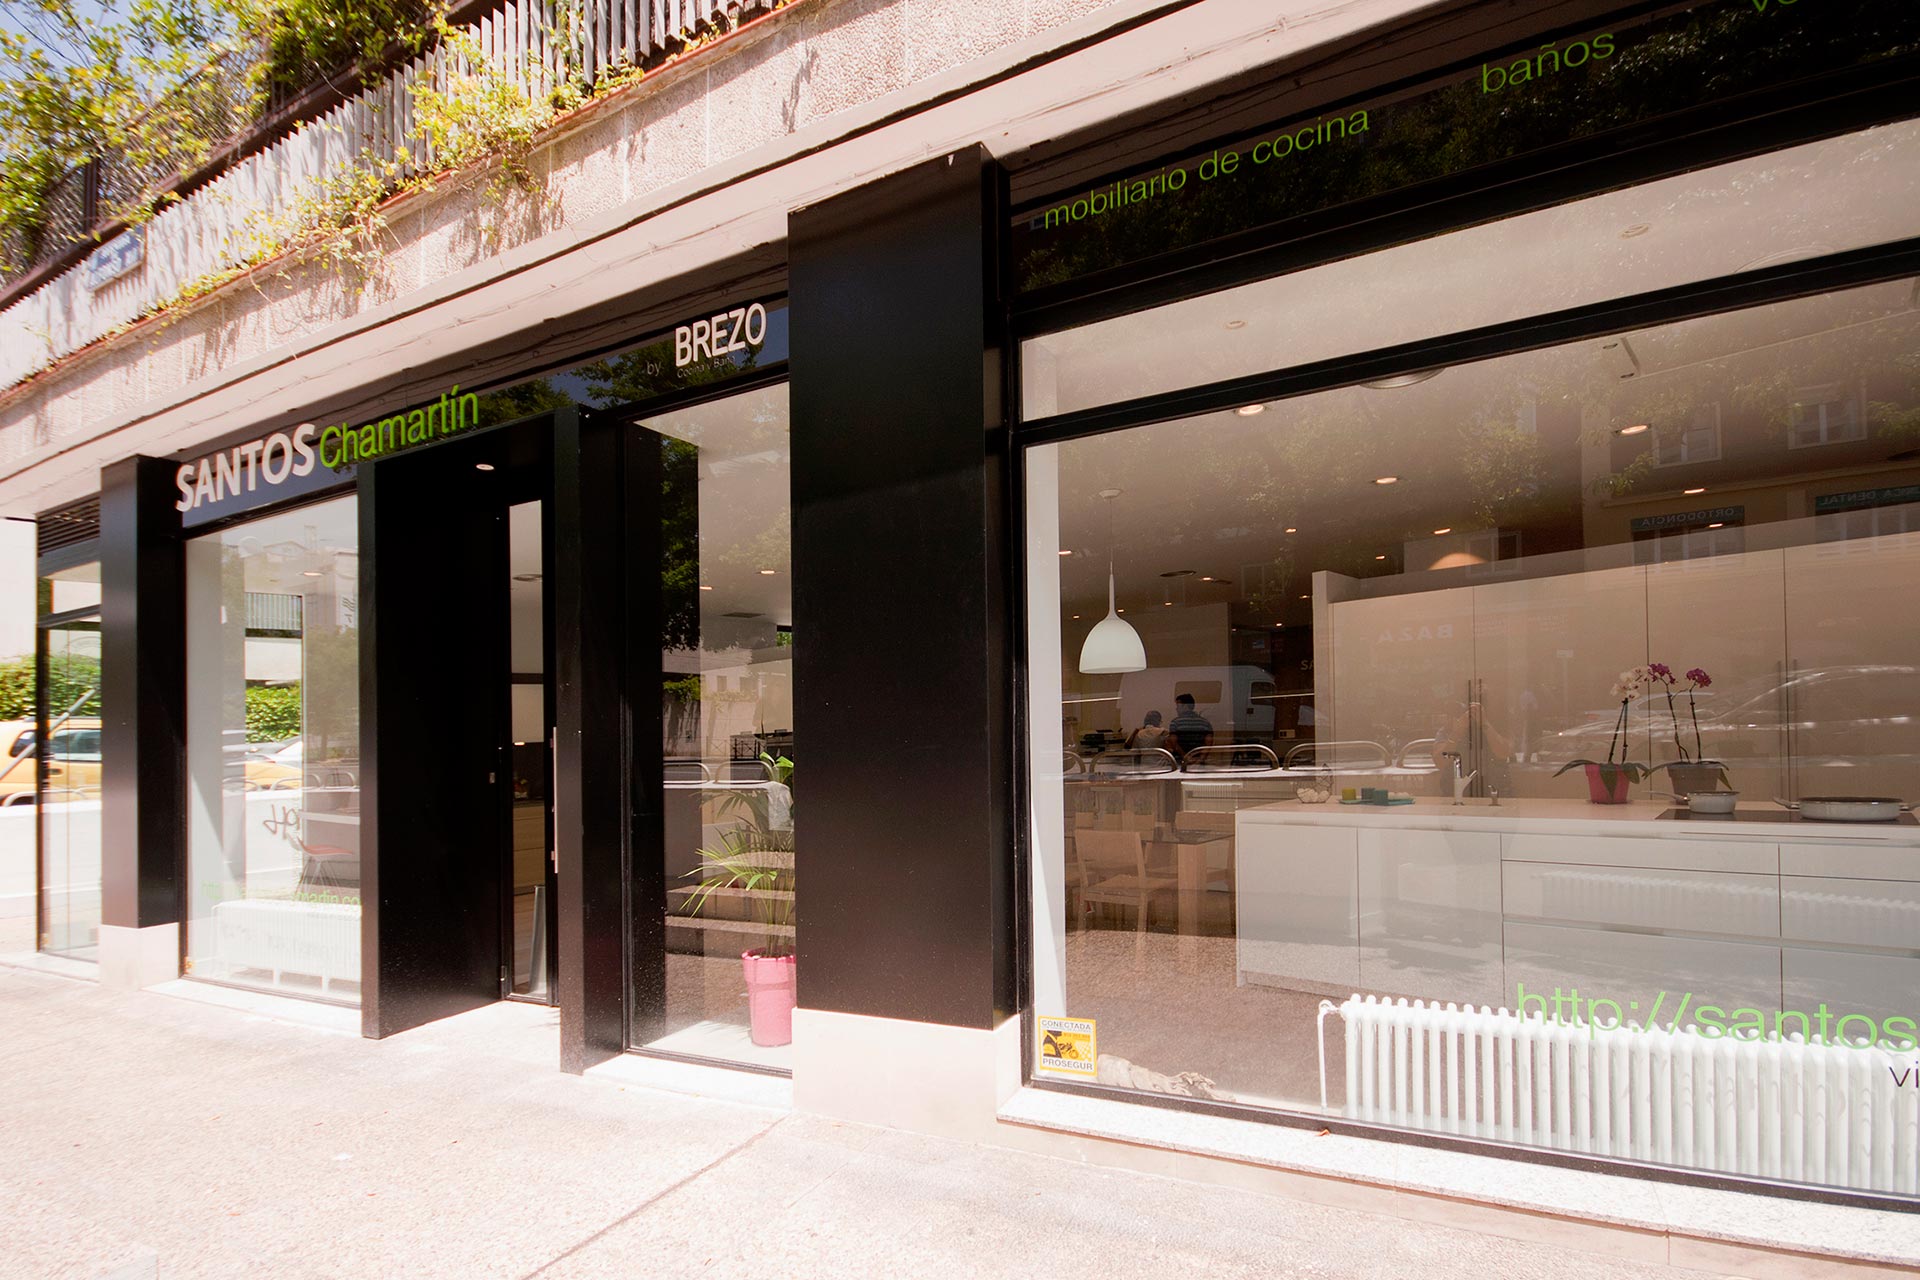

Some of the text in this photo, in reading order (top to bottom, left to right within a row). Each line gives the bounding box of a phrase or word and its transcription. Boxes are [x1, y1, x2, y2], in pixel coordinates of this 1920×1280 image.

[1482, 33, 1615, 93] baños
[1045, 108, 1370, 228] mobiliario de cocina
[647, 303, 767, 377] by BREZO
[176, 385, 479, 512] SANTOS Chamartín
[1041, 1019, 1092, 1031] CONECTADA
[1042, 1058, 1093, 1071] PROSEGUR
